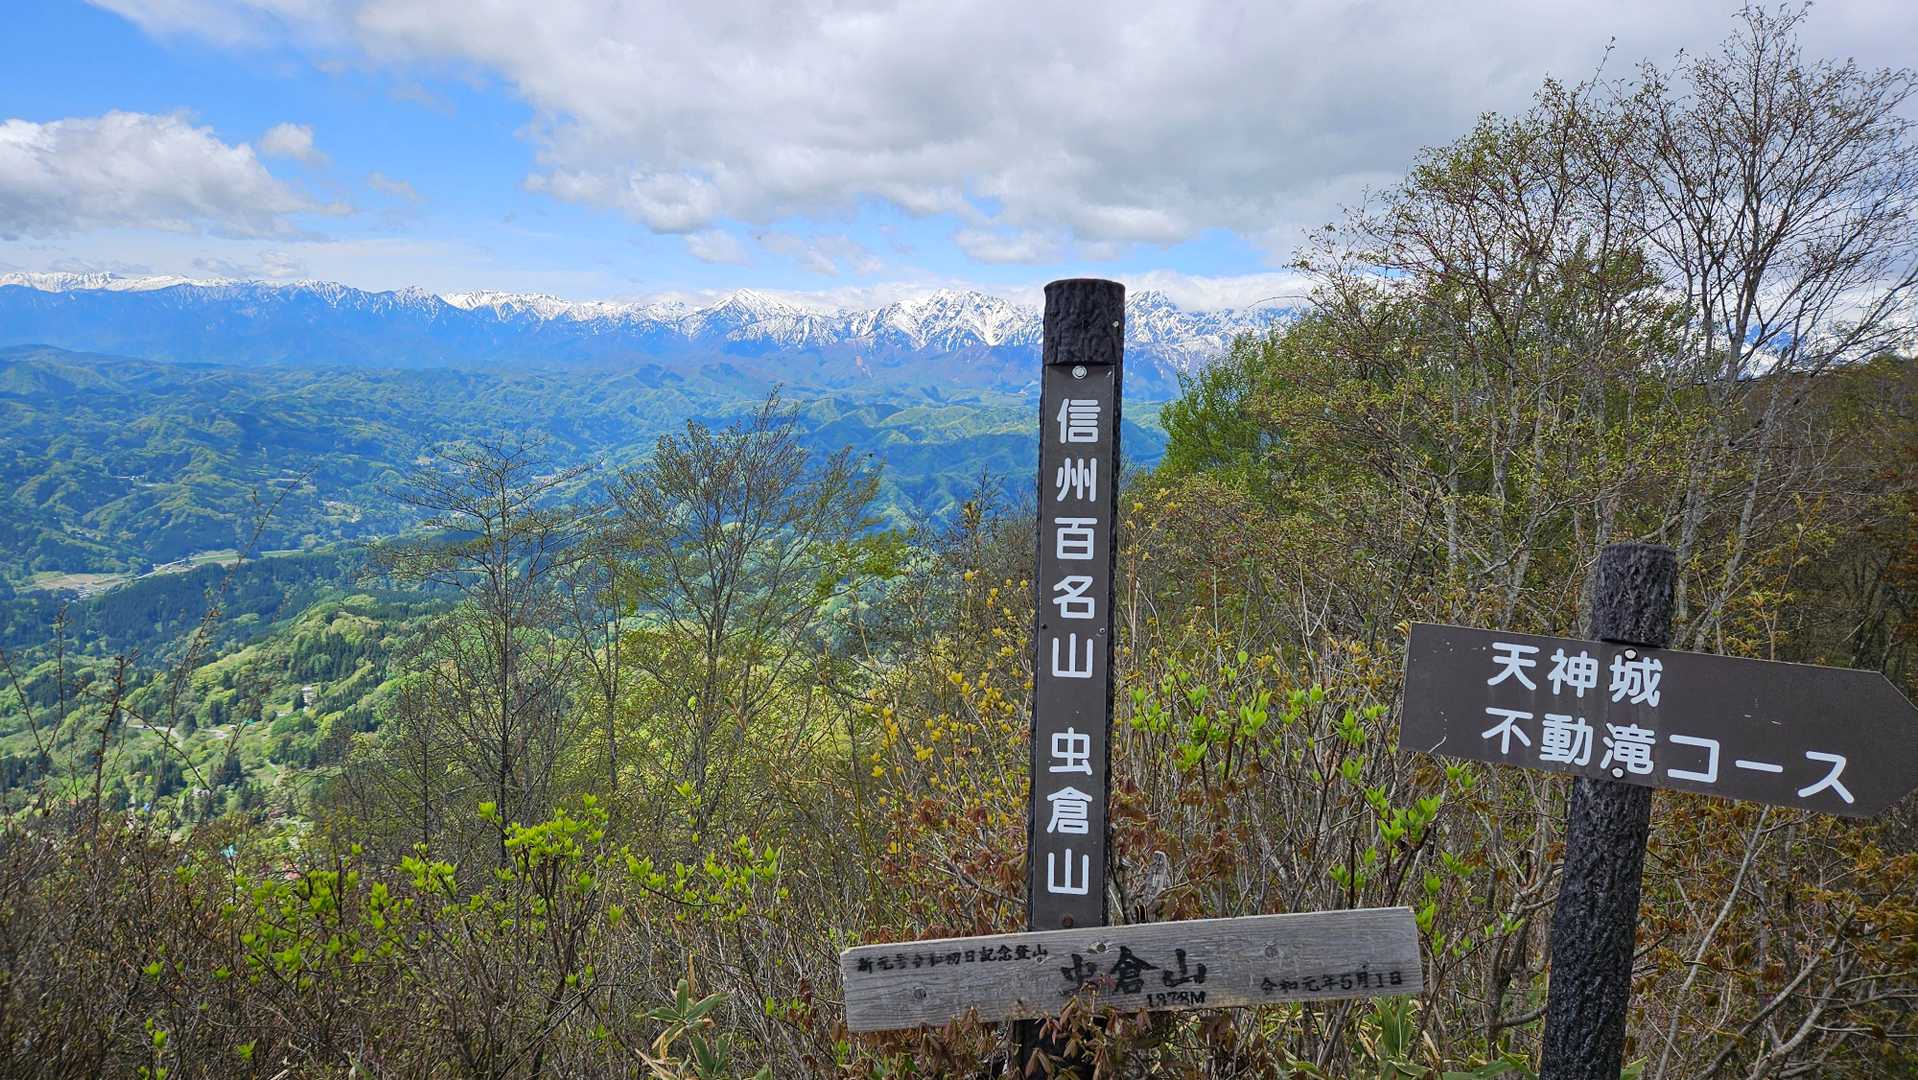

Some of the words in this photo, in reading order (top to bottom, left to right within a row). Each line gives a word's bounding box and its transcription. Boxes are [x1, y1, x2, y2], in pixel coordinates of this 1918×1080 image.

[1051, 398, 1101, 679] 信州百名山
[1486, 641, 1664, 708] 天神城
[1481, 706, 1855, 804] 不動滝コース
[1046, 726, 1094, 895] 虫倉山
[1260, 970, 1403, 995] 令和元年5月1日
